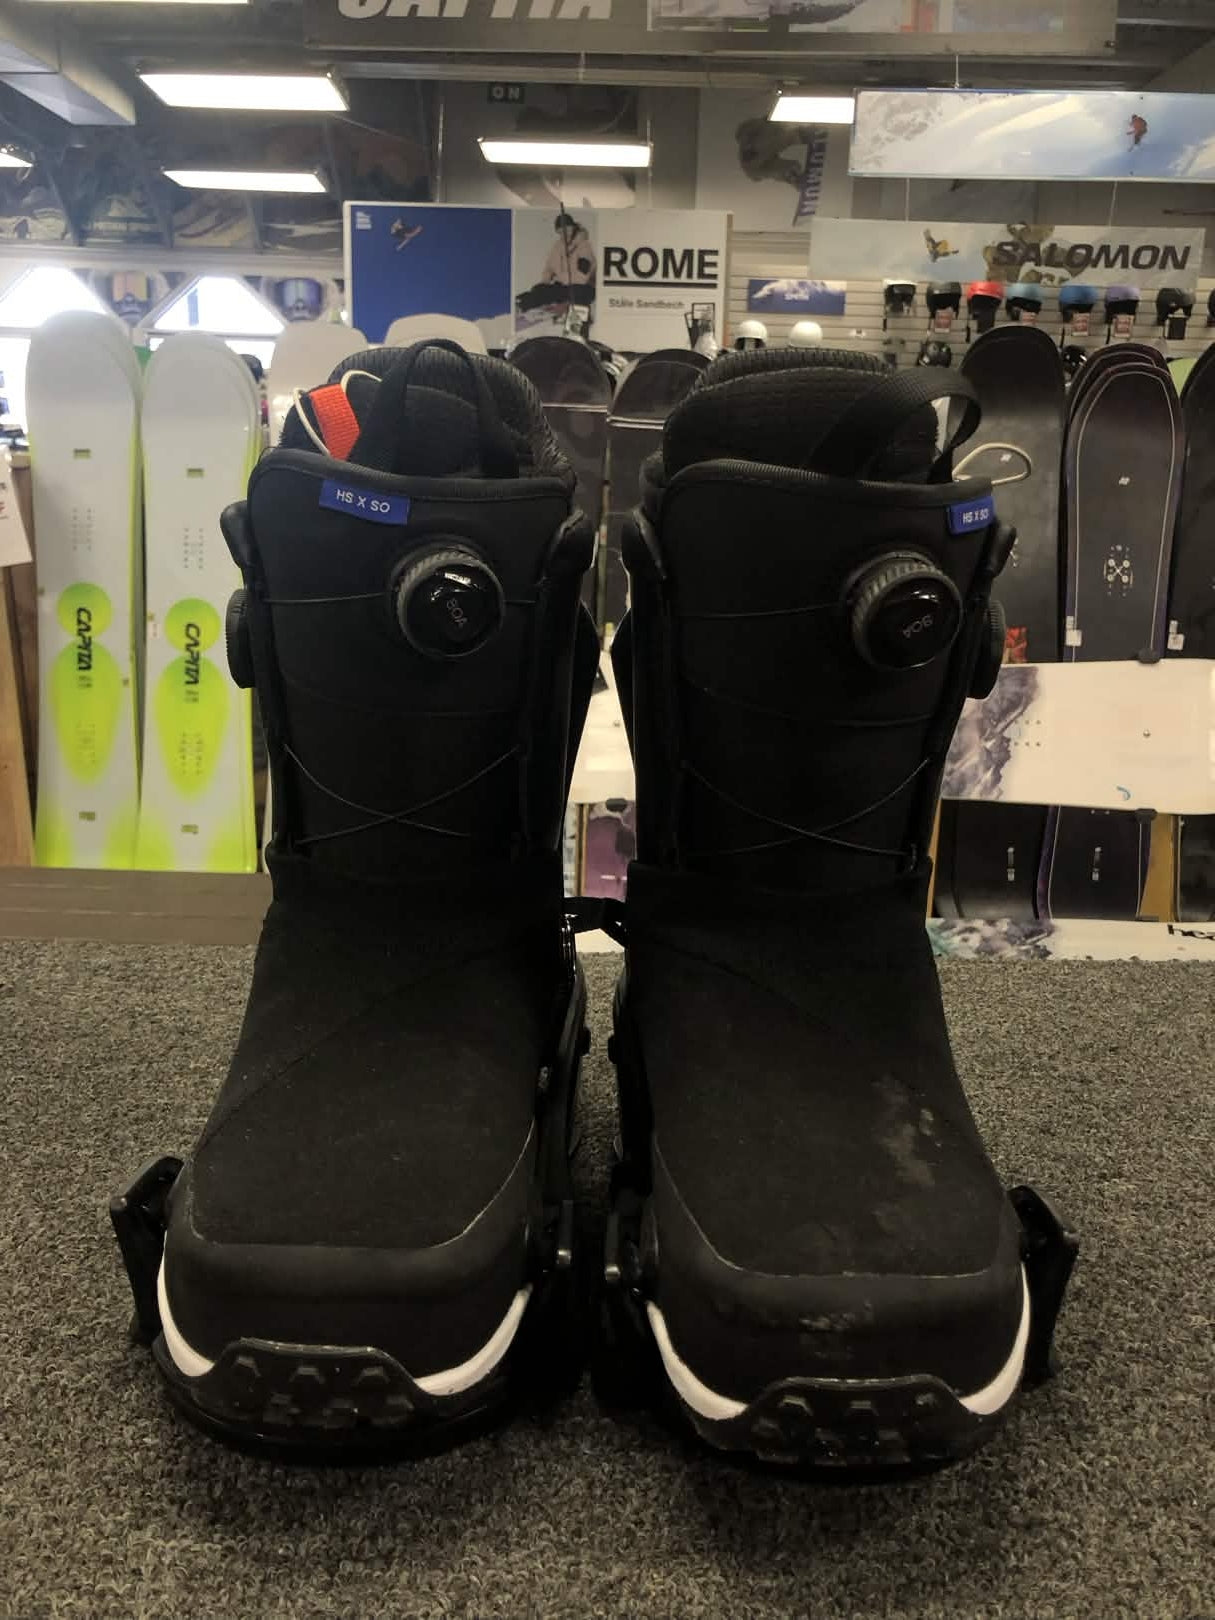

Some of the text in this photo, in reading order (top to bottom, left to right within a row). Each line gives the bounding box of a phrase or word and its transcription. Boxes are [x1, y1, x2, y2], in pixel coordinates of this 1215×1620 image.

[603, 246, 719, 279] ROME
[992, 241, 1191, 270] SALOMON
[336, 488, 391, 513] HS X SO
[77, 607, 93, 671] CAPITA
[185, 623, 200, 685] CAPITA
